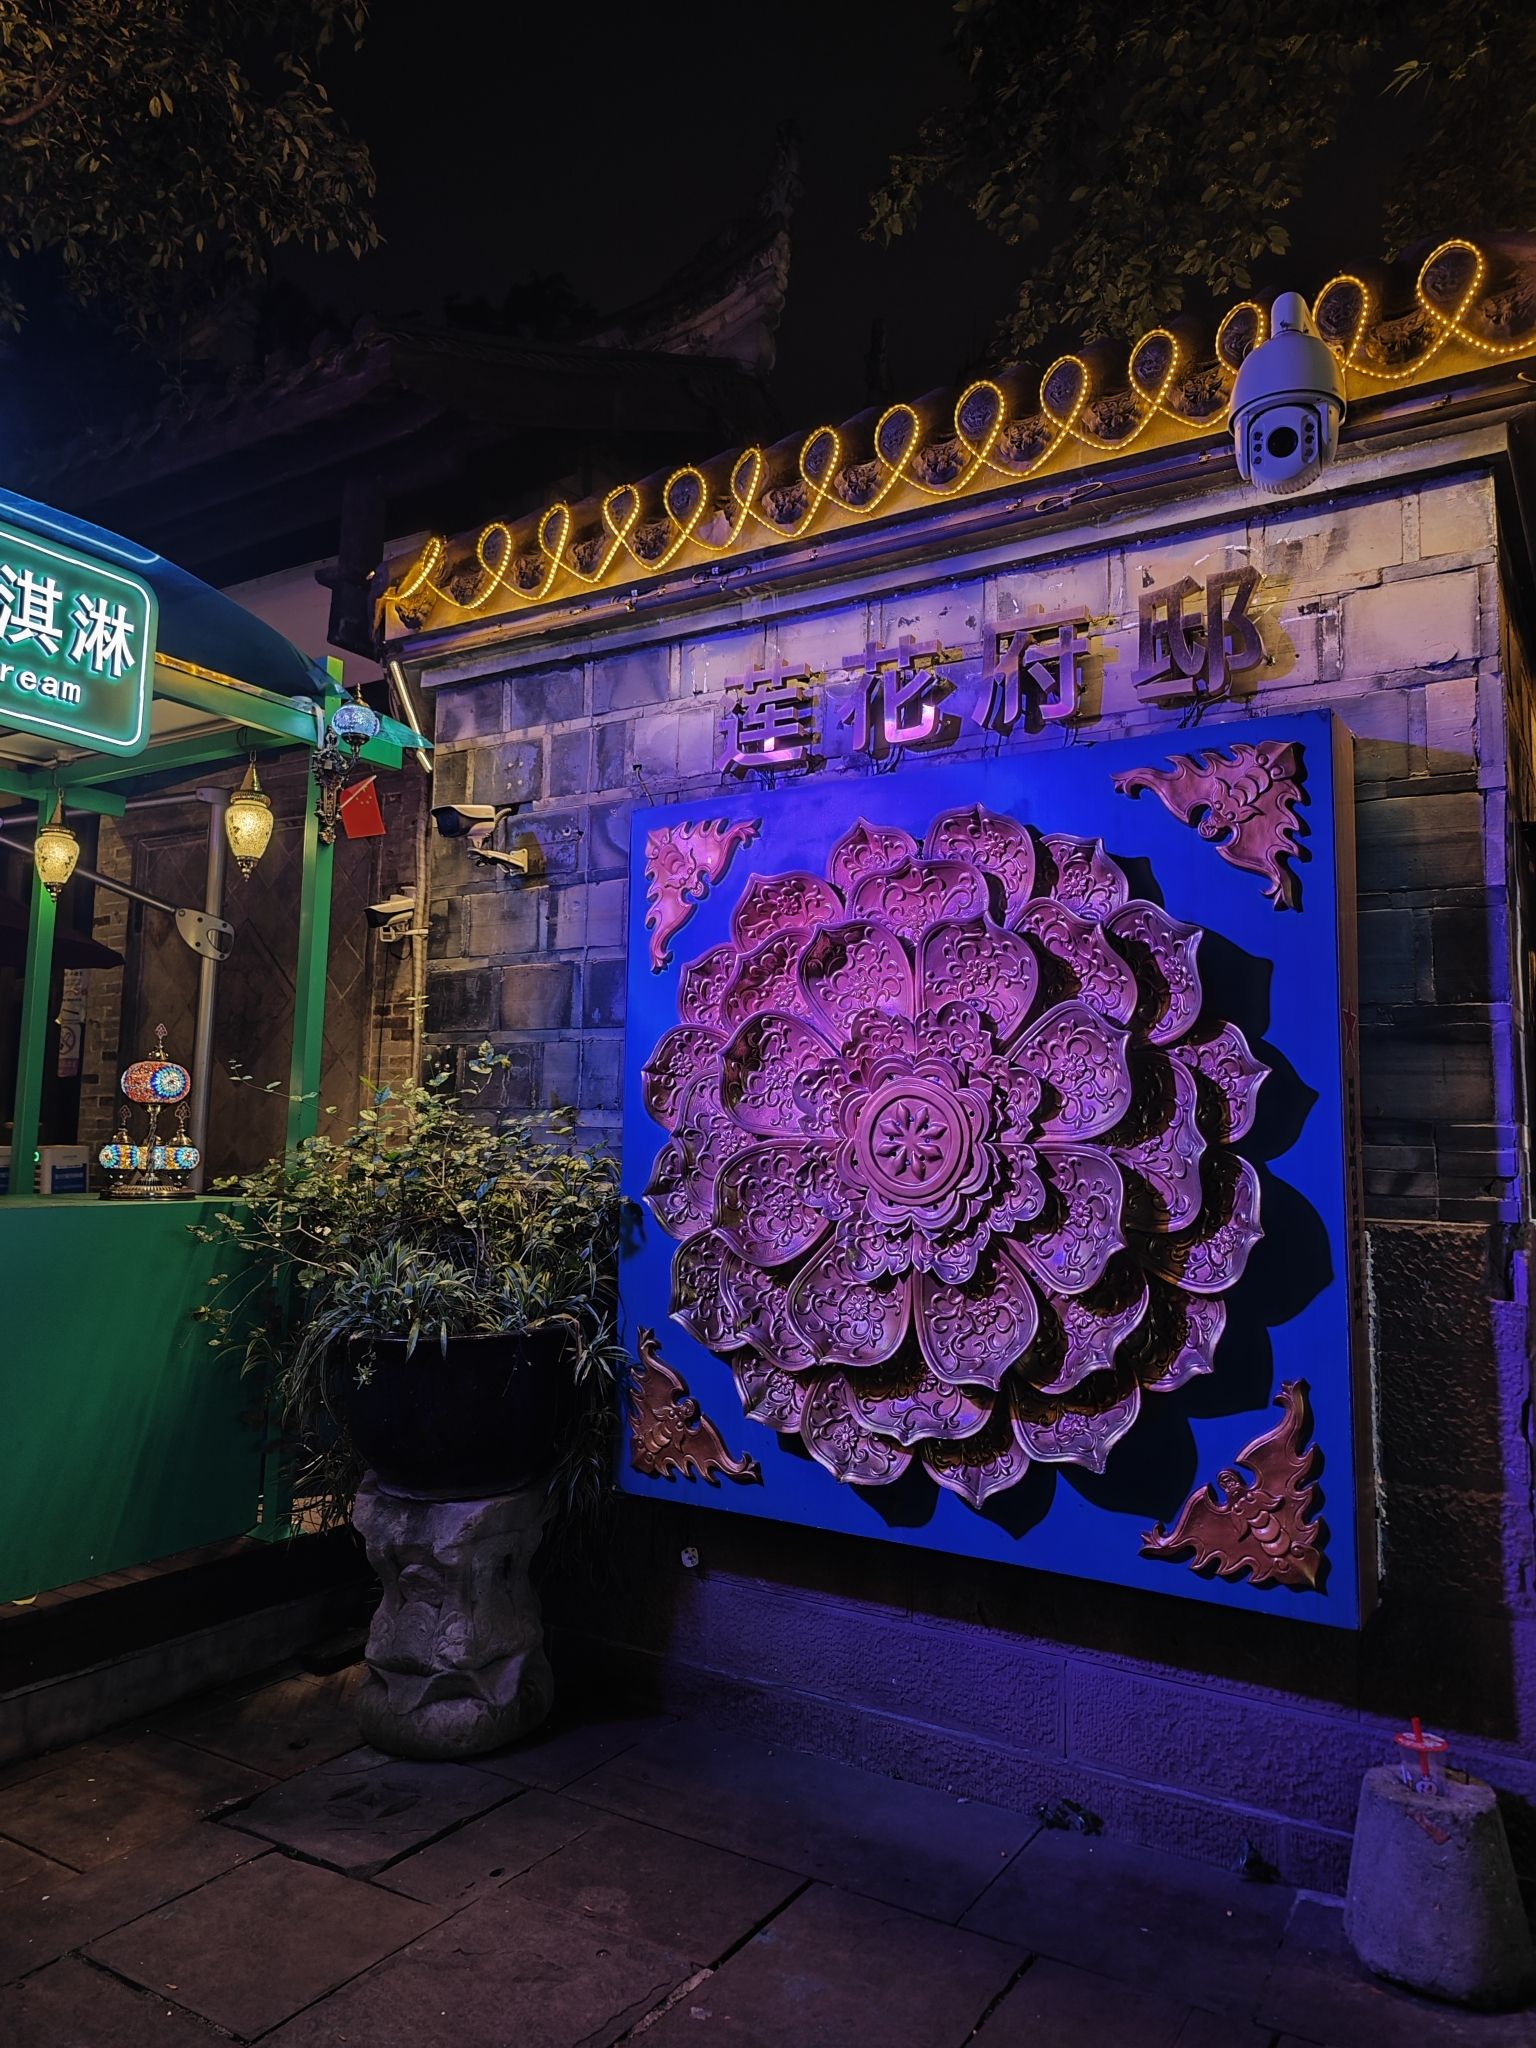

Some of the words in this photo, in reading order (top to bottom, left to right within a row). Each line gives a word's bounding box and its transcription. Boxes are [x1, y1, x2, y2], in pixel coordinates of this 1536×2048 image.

[0, 564, 135, 677] 淇淋
[716, 565, 1264, 772] 莲花府邸
